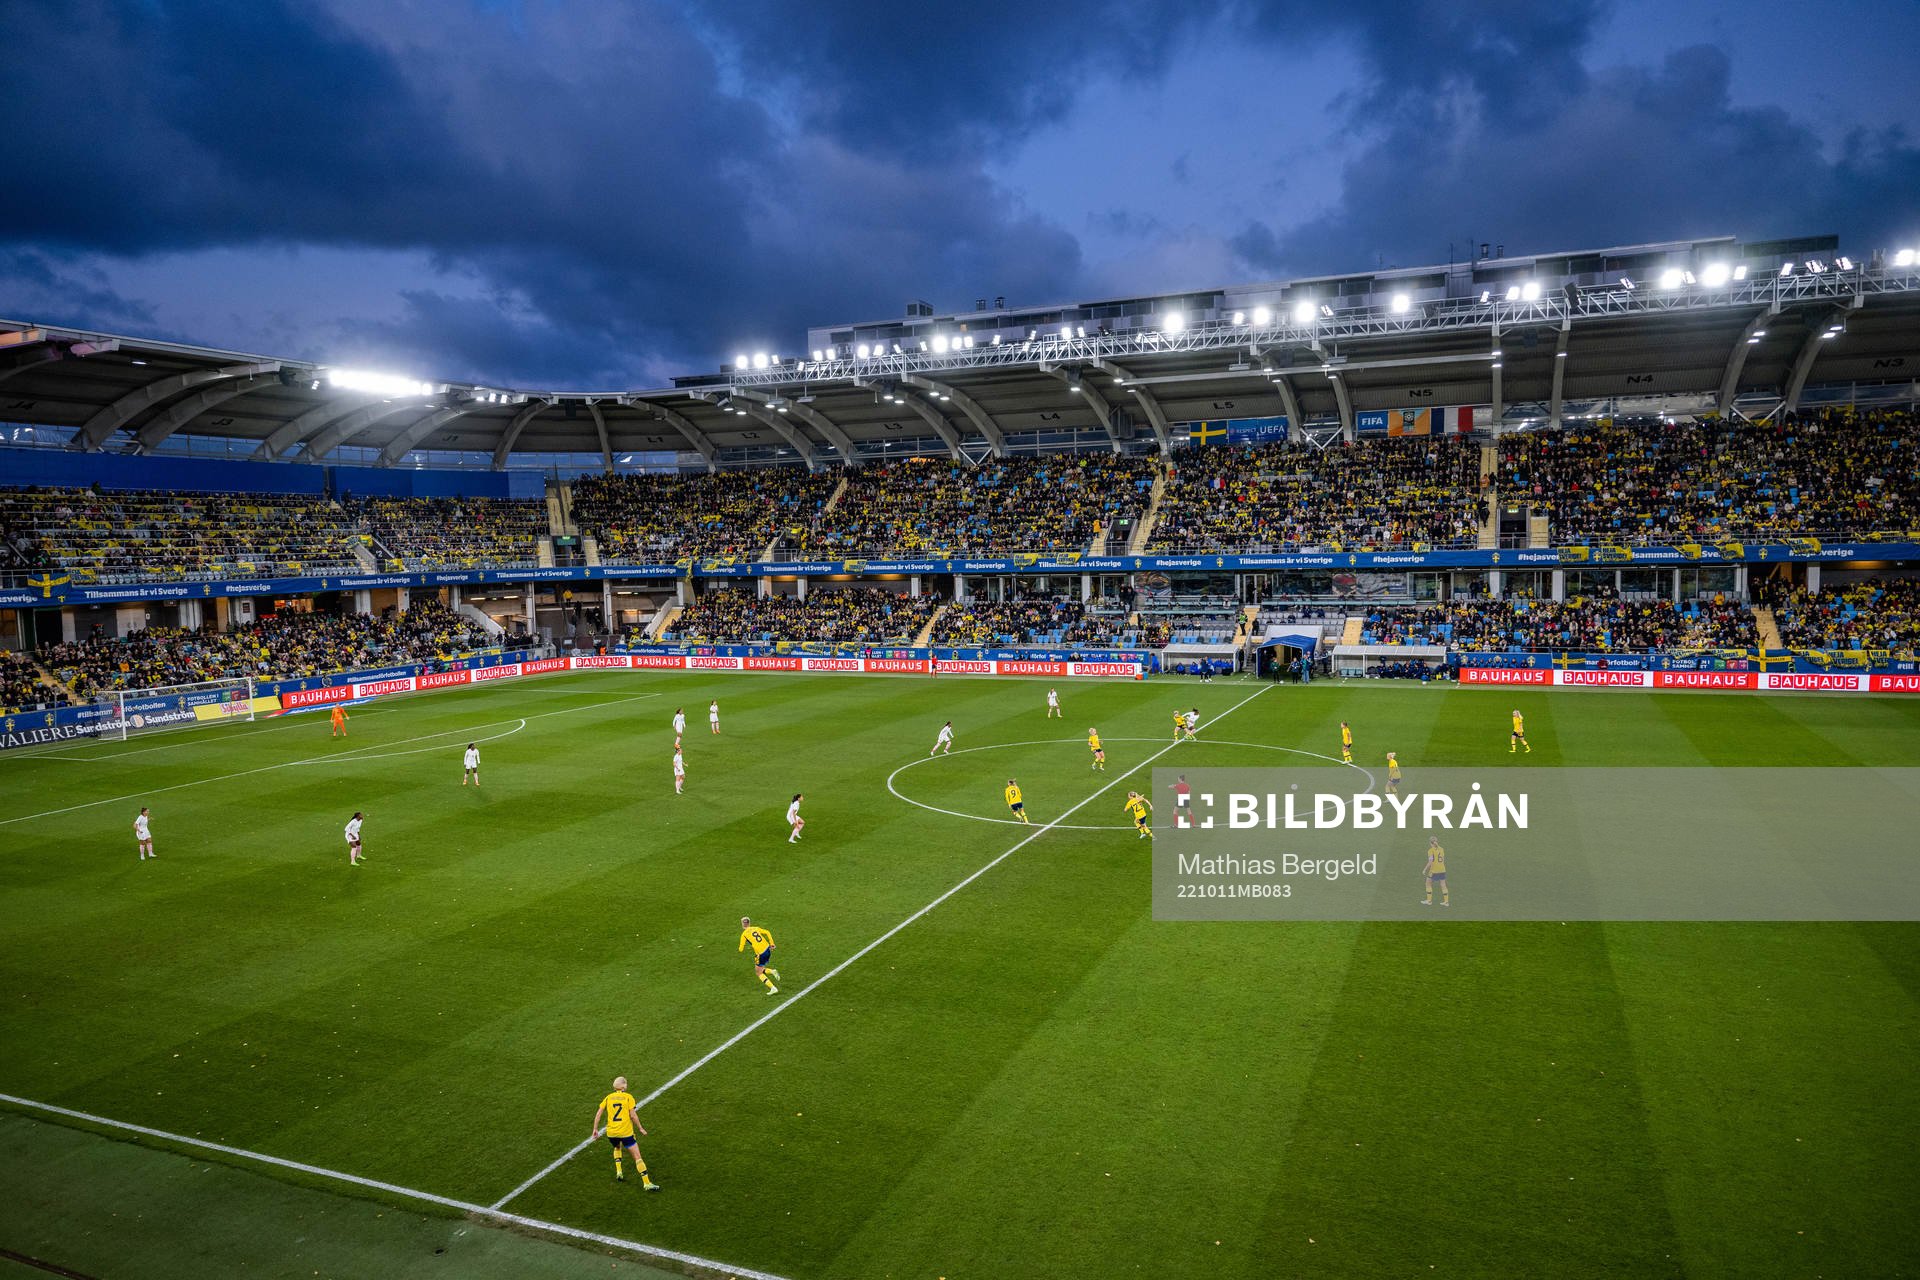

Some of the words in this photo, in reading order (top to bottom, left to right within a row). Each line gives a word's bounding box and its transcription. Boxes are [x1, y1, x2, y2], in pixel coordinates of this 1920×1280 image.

[1409, 388, 1433, 397] N5
[1213, 402, 1234, 410] L5
[1361, 417, 1383, 426] FIFA
[1260, 424, 1285, 434] UEFA
[1095, 560, 1121, 568] Sverige
[1156, 559, 1202, 567] #hejasverige
[1303, 557, 1333, 565] Sverige
[549, 570, 573, 578] Sverige
[85, 590, 139, 599] Tillsammans
[158, 587, 188, 596] Sverige
[226, 583, 271, 593] #hejasverige
[526, 659, 565, 672] BAUHAUS
[576, 657, 627, 667] BAUHAUS
[637, 657, 681, 666] BAUHAUS
[692, 658, 737, 667] BAUHAUS
[749, 659, 797, 668] BAUHAUS
[808, 660, 859, 669] BAUHAUS
[871, 661, 922, 670] BAUHAUS
[936, 662, 990, 672] BAUHAUS
[1004, 663, 1060, 673] BAUHAUS
[1074, 664, 1135, 675] BAUHAUS
[477, 665, 518, 680] BAUHAUS
[1469, 670, 1545, 682] BAUHAUS
[1564, 671, 1643, 684] BAUHAUS
[422, 672, 466, 686] BAUHAUS
[1664, 674, 1747, 685] BAUHAUS
[1769, 676, 1858, 688] BAUHAUS
[360, 679, 411, 696] BAUHAUS
[290, 688, 347, 704] BAUHAUS
[145, 710, 196, 724] Sundström
[1010, 789, 1017, 799] 9
[752, 931, 762, 943] 8
[612, 1103, 622, 1122] 2
